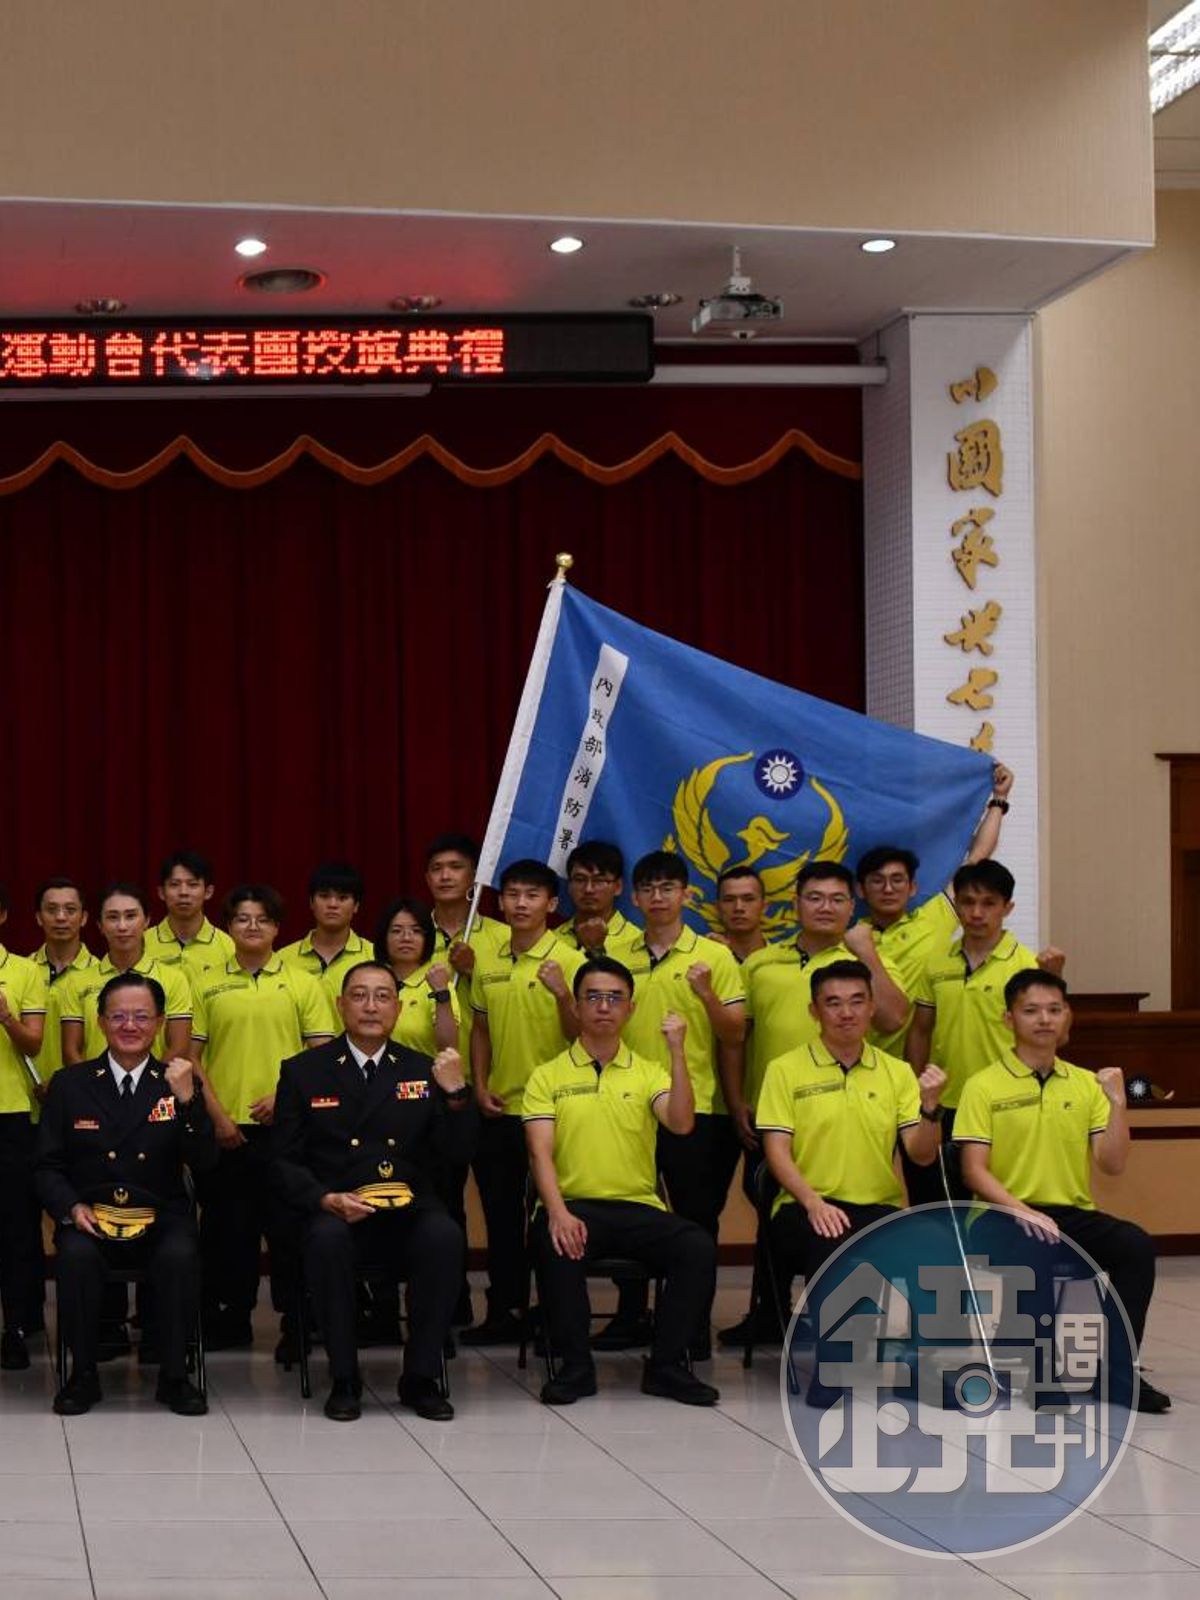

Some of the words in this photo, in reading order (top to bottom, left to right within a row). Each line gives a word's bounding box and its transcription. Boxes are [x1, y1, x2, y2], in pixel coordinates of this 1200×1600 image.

[557, 677, 613, 850] 內政部消防署
